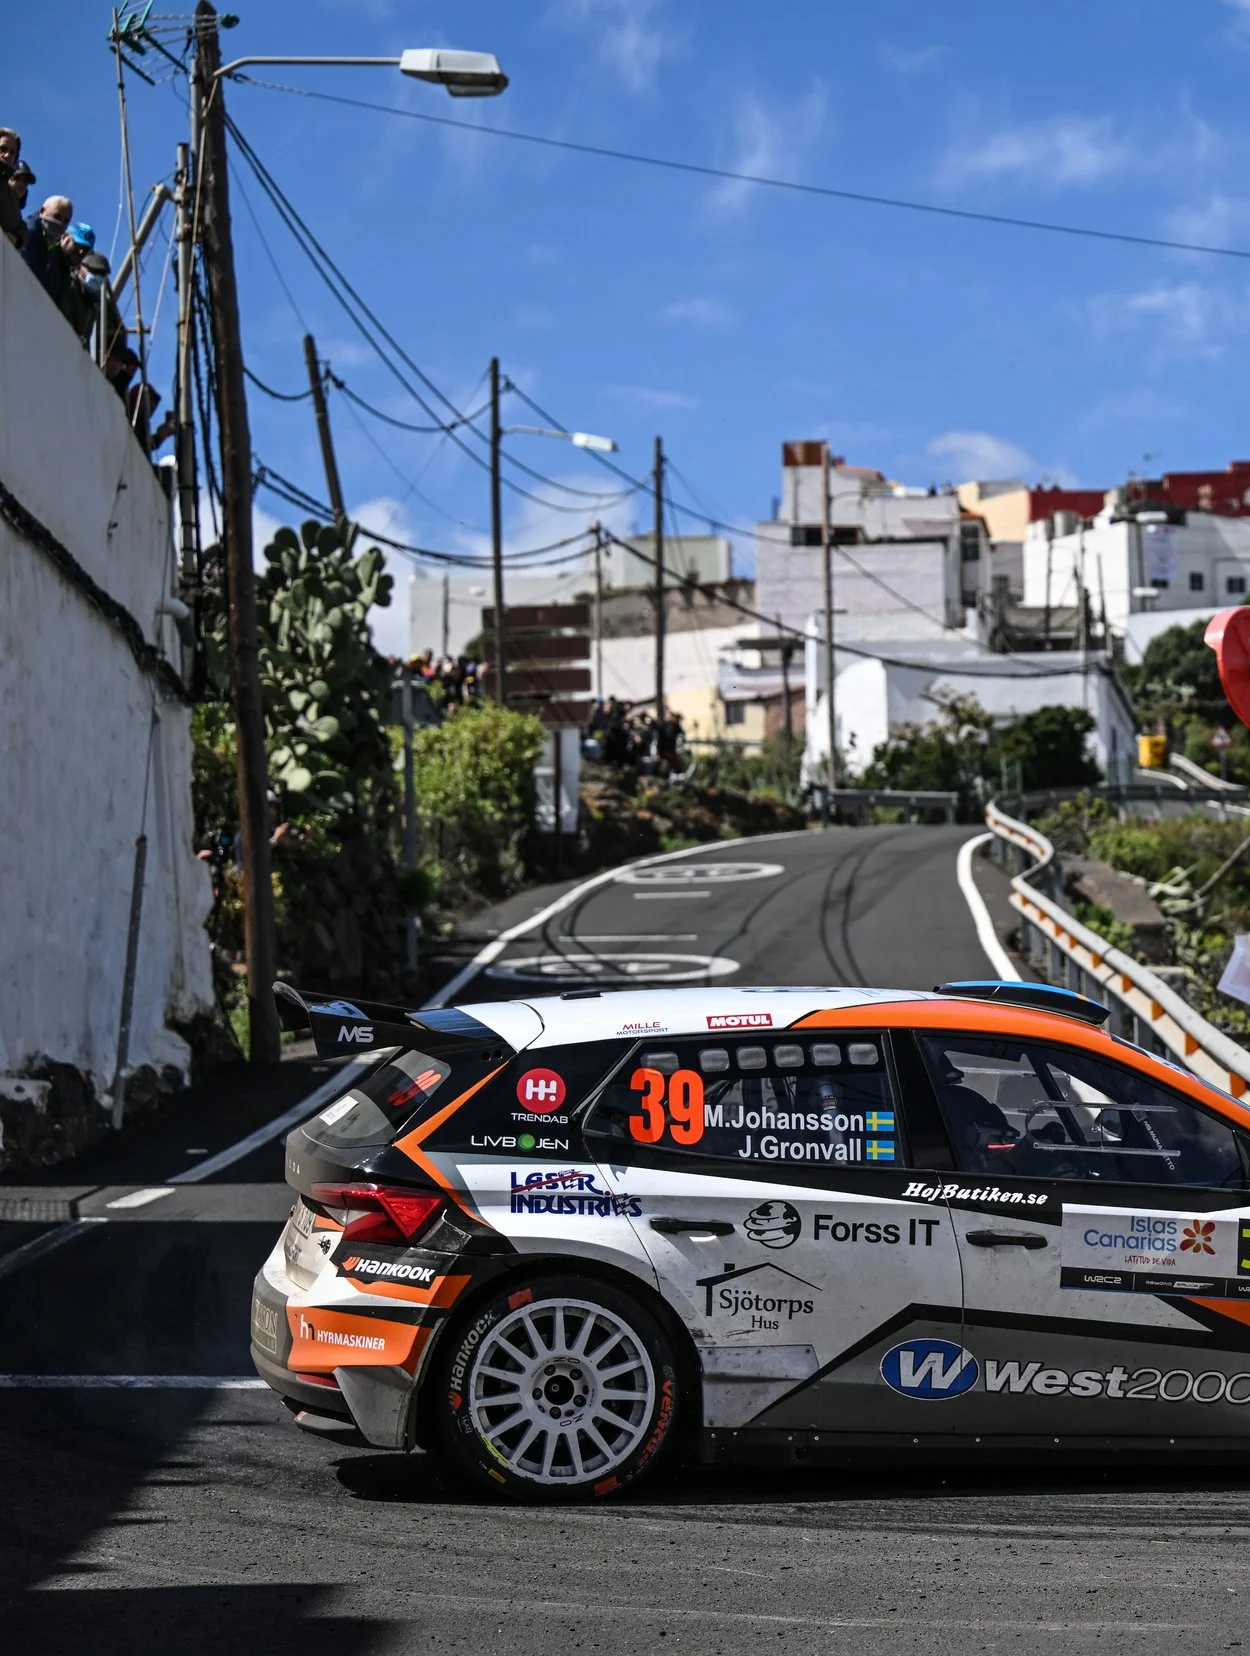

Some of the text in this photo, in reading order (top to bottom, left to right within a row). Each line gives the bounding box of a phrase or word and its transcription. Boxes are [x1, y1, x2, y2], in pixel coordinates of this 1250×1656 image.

[616, 1027, 669, 1036] MOTORSPORT
[622, 1021, 661, 1031] MILLE
[710, 1015, 771, 1027] MOTUL
[337, 1025, 374, 1043] MS
[629, 1067, 704, 1146] 39
[511, 1112, 568, 1124] TRENDAB
[704, 1104, 864, 1132] M.Johansson
[738, 1135, 861, 1161] J.Gronvall
[511, 1192, 643, 1217] INDUSTRIES
[813, 1213, 941, 1246] Forss IT
[1130, 1215, 1178, 1236] Islas
[1083, 1228, 1178, 1252] Canarias
[1124, 1254, 1177, 1267] LATITUD DE VIDA
[719, 1287, 815, 1320] Sjötorps
[751, 1315, 780, 1330] Hus
[317, 1329, 385, 1351] HYRMASKINER
